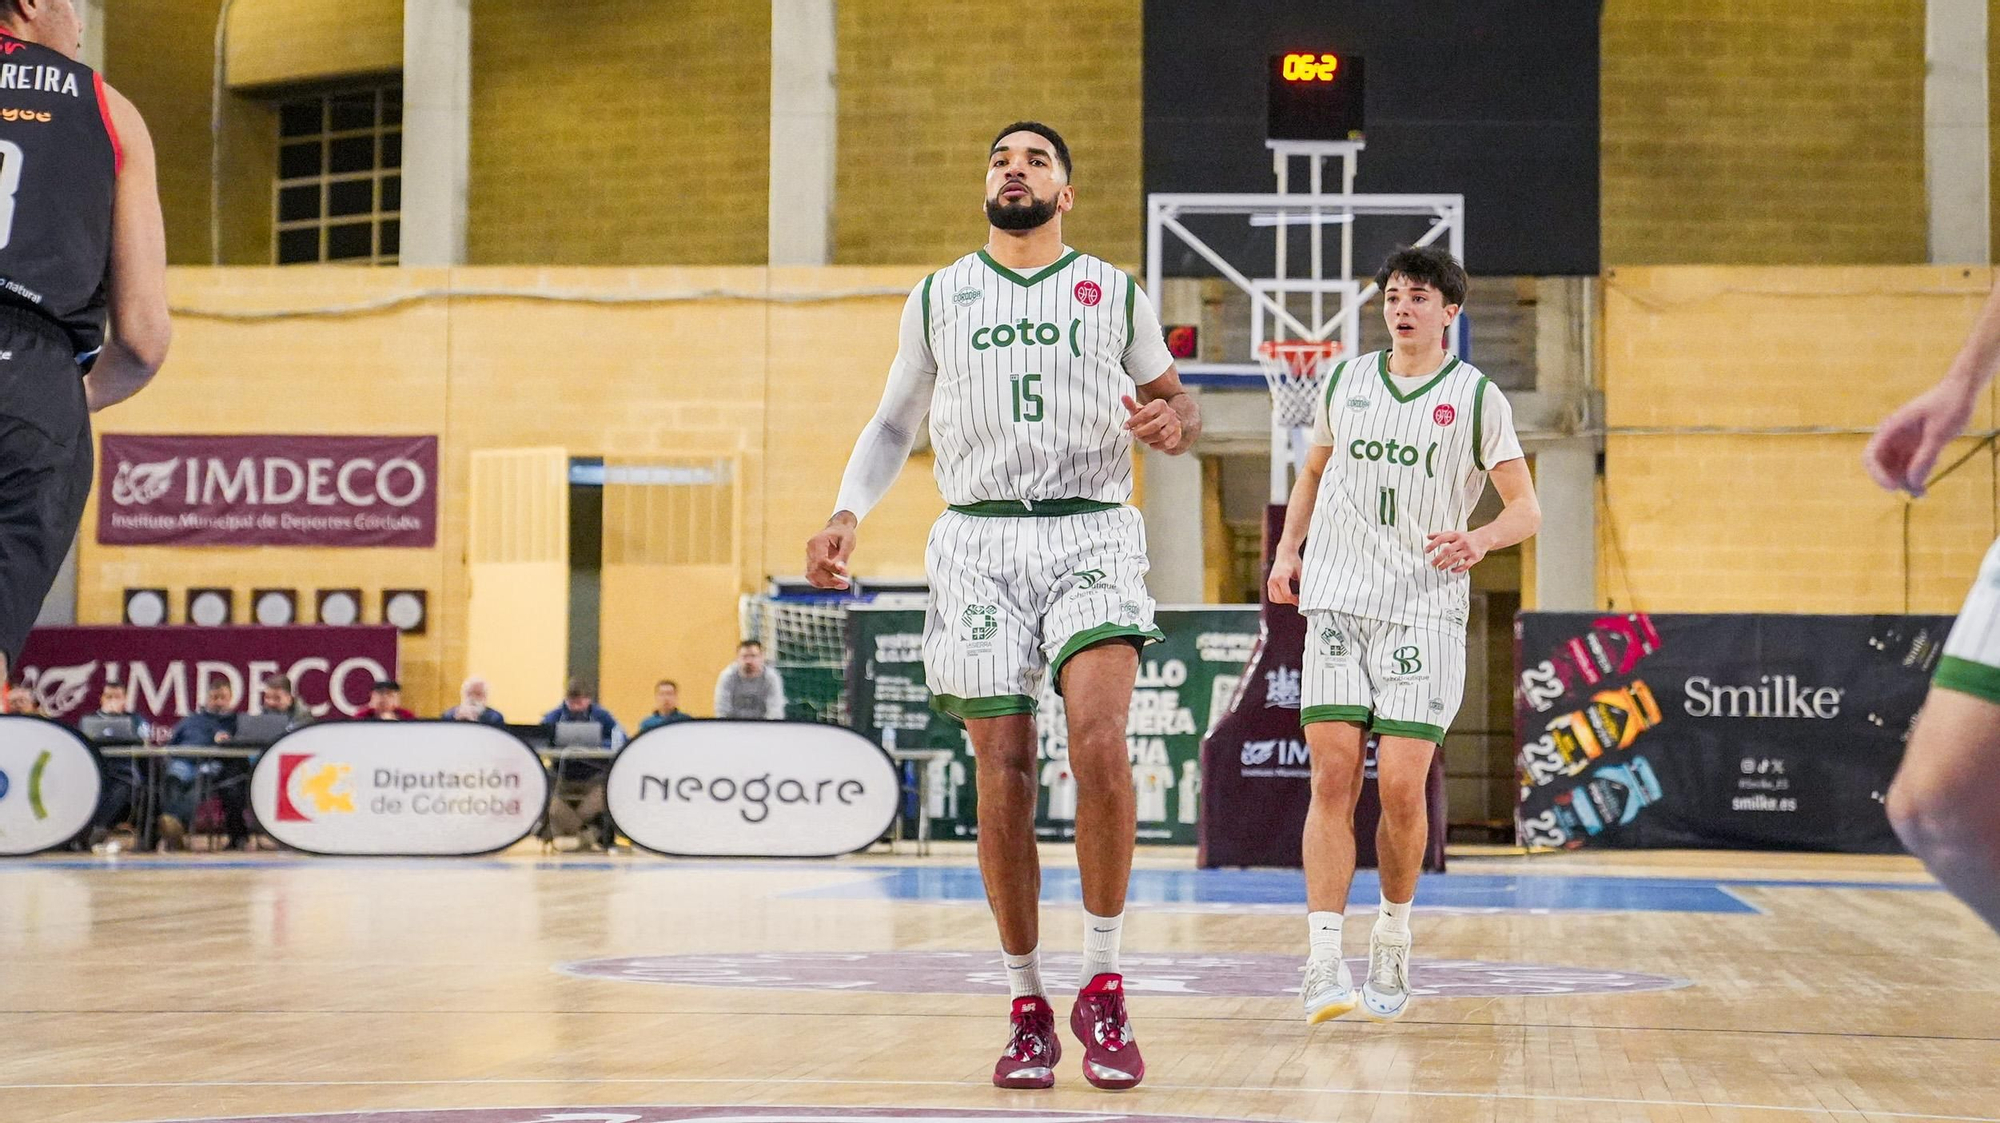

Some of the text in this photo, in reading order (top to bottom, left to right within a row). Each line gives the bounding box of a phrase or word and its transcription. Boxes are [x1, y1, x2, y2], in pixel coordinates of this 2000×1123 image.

[5, 281, 42, 304] natural
[971, 318, 1060, 350] coto
[1010, 374, 1044, 422] 15
[1350, 438, 1419, 467] coto
[184, 456, 427, 507] IMDECO
[1379, 486, 1396, 527] 11
[1684, 674, 1841, 719] Smilke
[374, 769, 520, 792] Diputación
[371, 796, 402, 815] de
